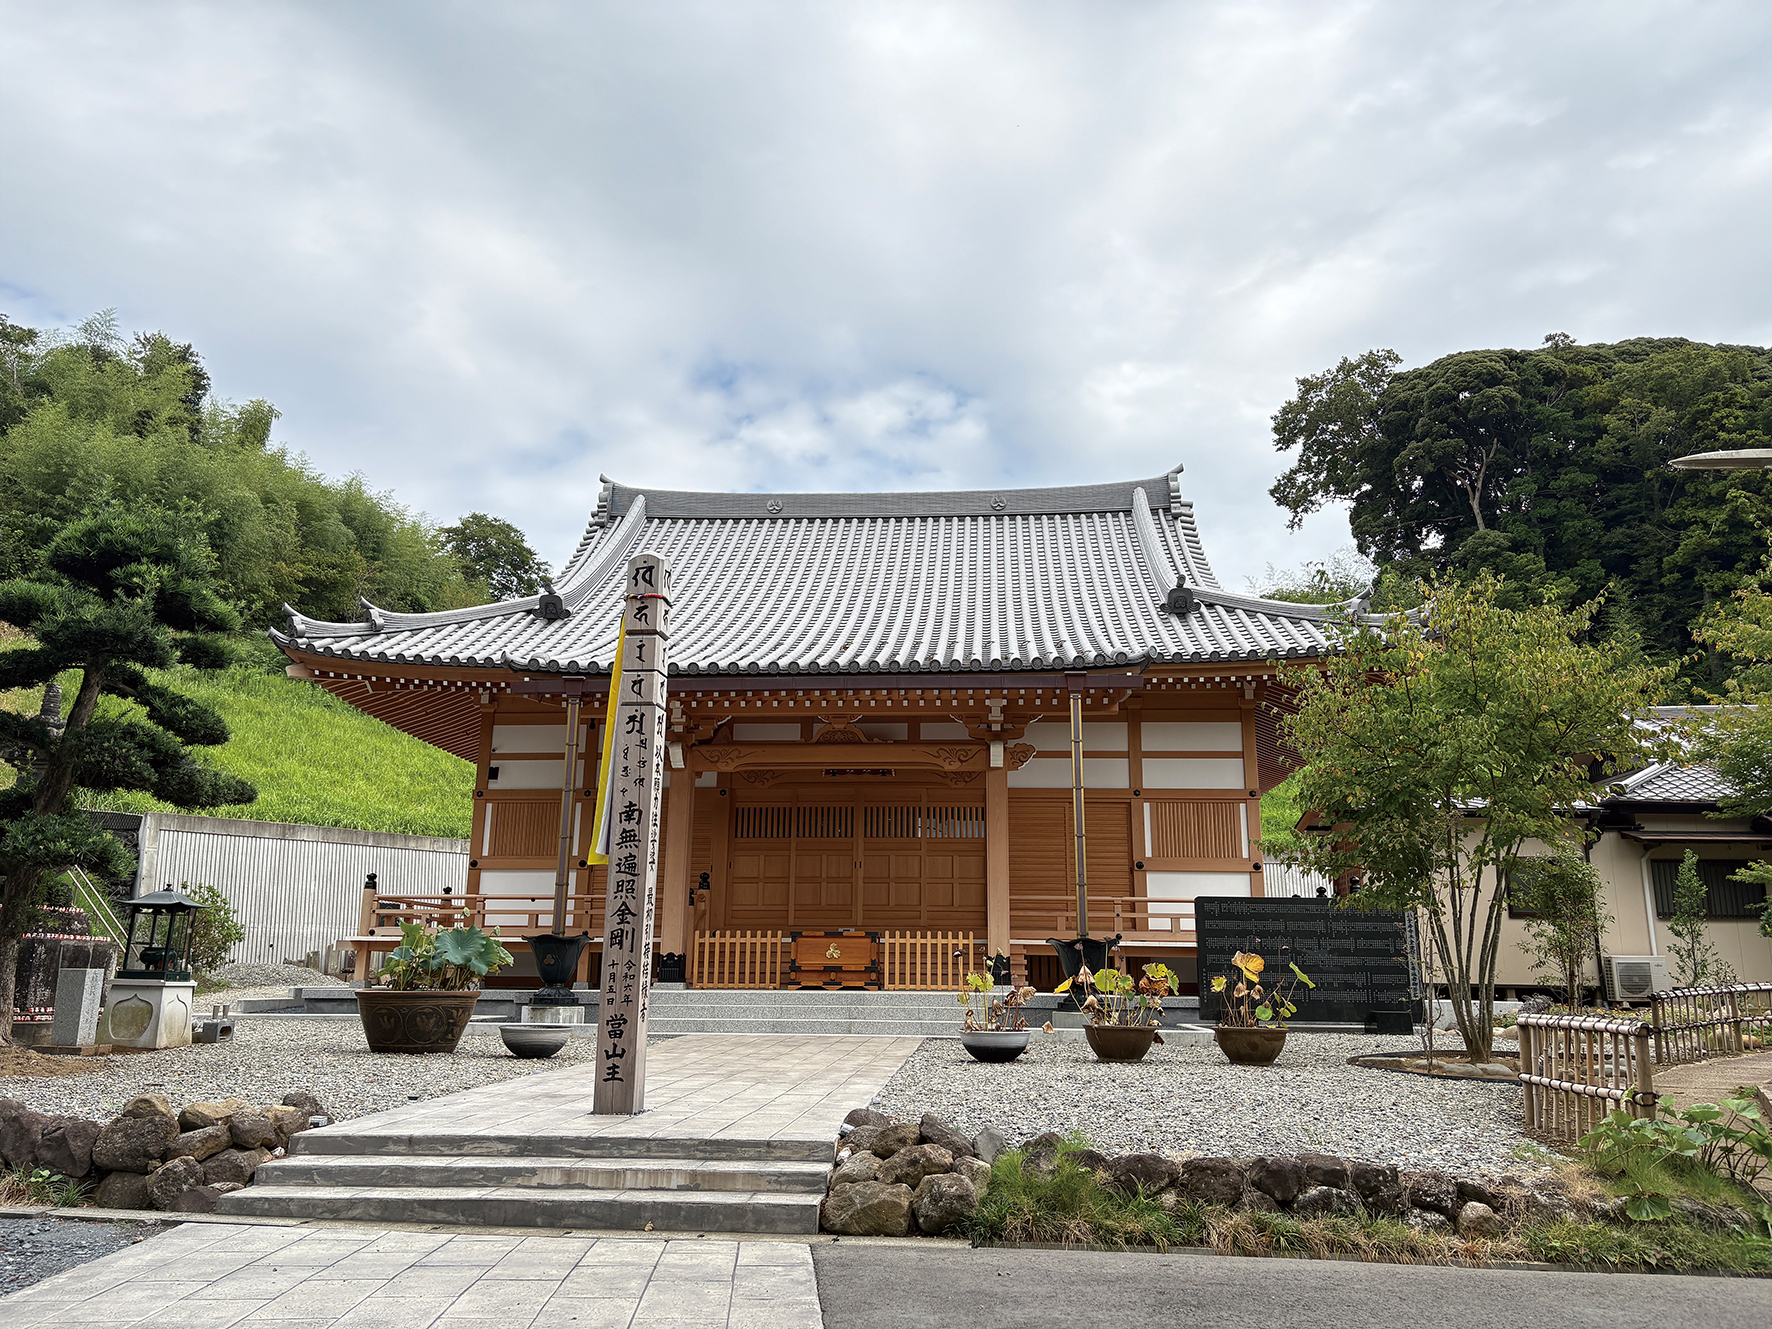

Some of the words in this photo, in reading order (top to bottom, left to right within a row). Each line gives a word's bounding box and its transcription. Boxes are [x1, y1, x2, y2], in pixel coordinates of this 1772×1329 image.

[609, 800, 643, 954] 南無遍照金剛
[605, 959, 620, 1006] 十月五日
[620, 958, 637, 1007] 令和六年
[602, 1012, 629, 1083] 當山主
